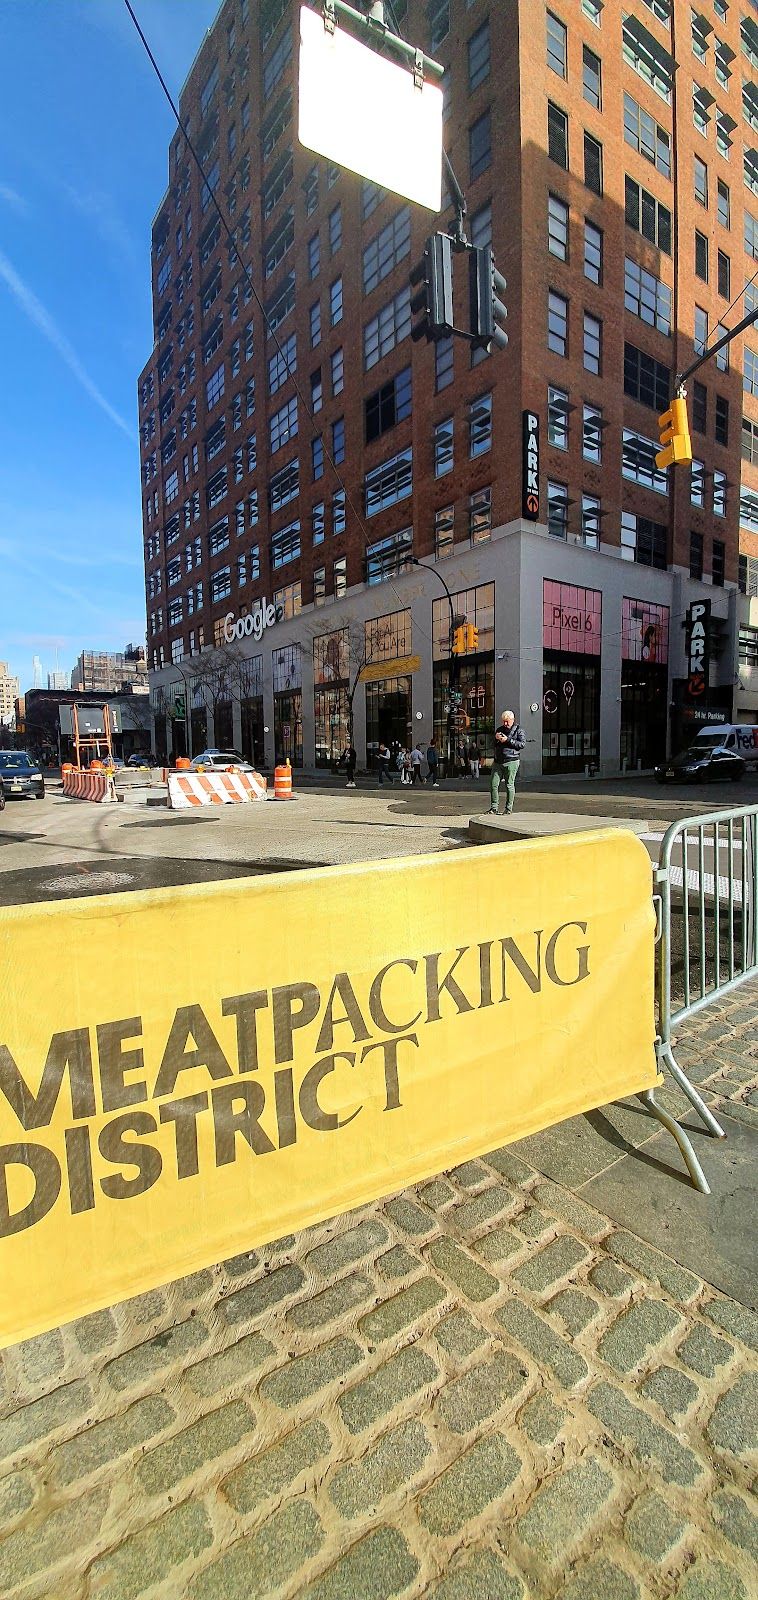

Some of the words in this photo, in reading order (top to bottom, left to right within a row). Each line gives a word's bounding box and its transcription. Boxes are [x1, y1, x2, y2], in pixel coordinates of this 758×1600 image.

[527, 414, 538, 489] PARK
[224, 596, 276, 643] Google
[552, 606, 582, 630] Pixel
[585, 614, 593, 632] 6
[690, 604, 706, 672] PARK
[694, 710, 701, 719] 24
[707, 711, 725, 721] Parking
[0, 921, 591, 1132] MEATPACKING
[0, 1034, 419, 1239] DISTRICT
